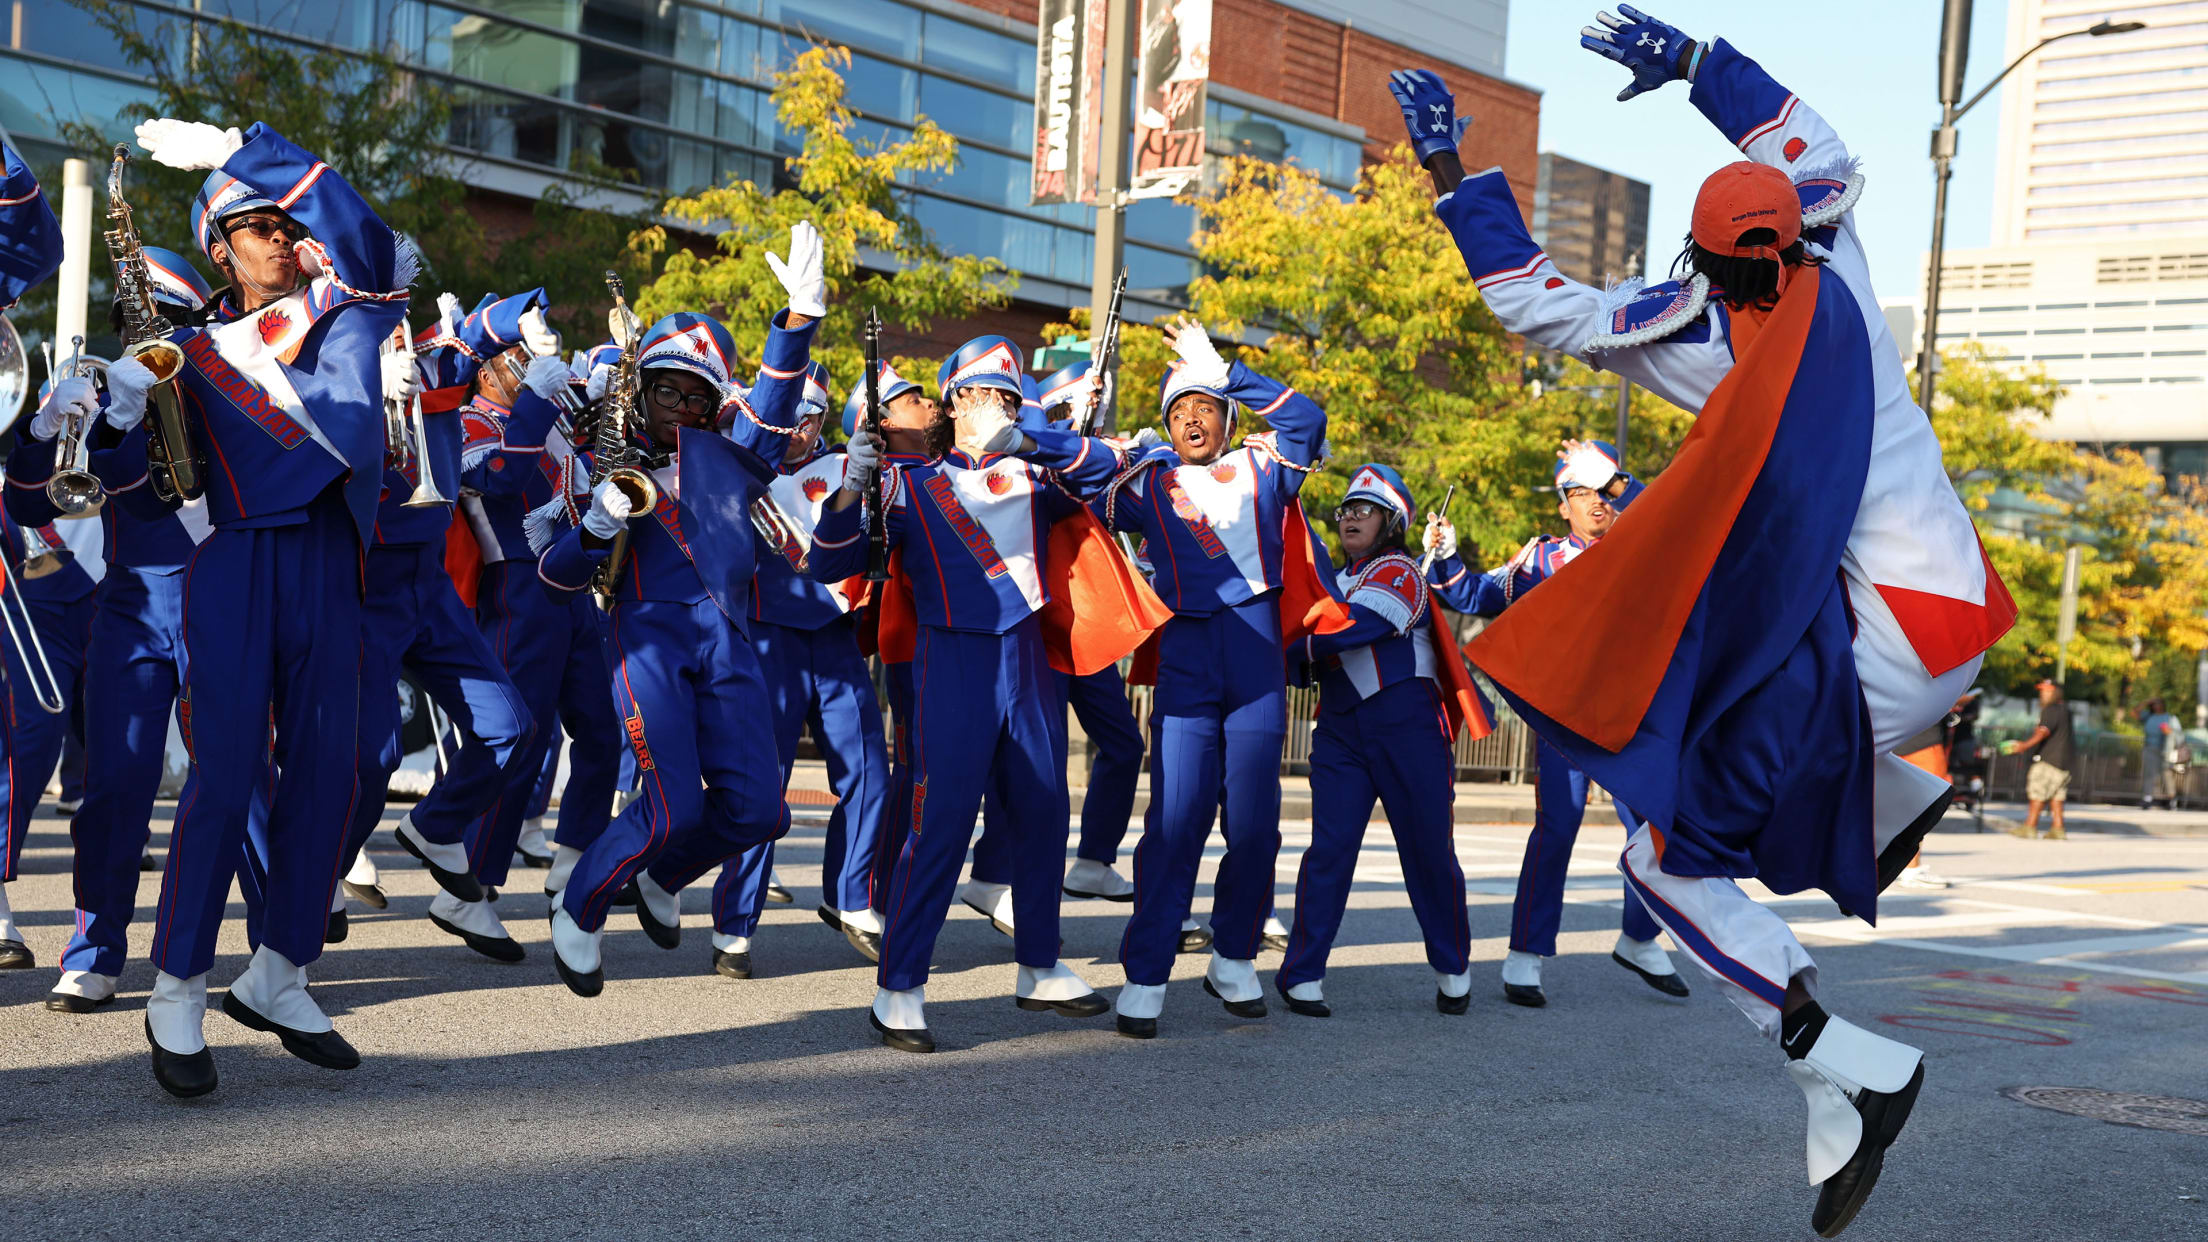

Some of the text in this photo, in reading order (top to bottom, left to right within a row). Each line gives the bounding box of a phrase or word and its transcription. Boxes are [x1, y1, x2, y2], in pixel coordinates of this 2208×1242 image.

[1047, 15, 1075, 172] BAUTISTA
[1036, 171, 1066, 198] 74
[692, 337, 709, 356] M
[1001, 358, 1011, 373] M
[183, 331, 307, 446] MORGAN STATE
[926, 473, 1008, 577] MORGAN STATE
[1190, 515, 1225, 556] STATE
[627, 715, 653, 769] BEARS
[912, 784, 926, 832] BEARS
